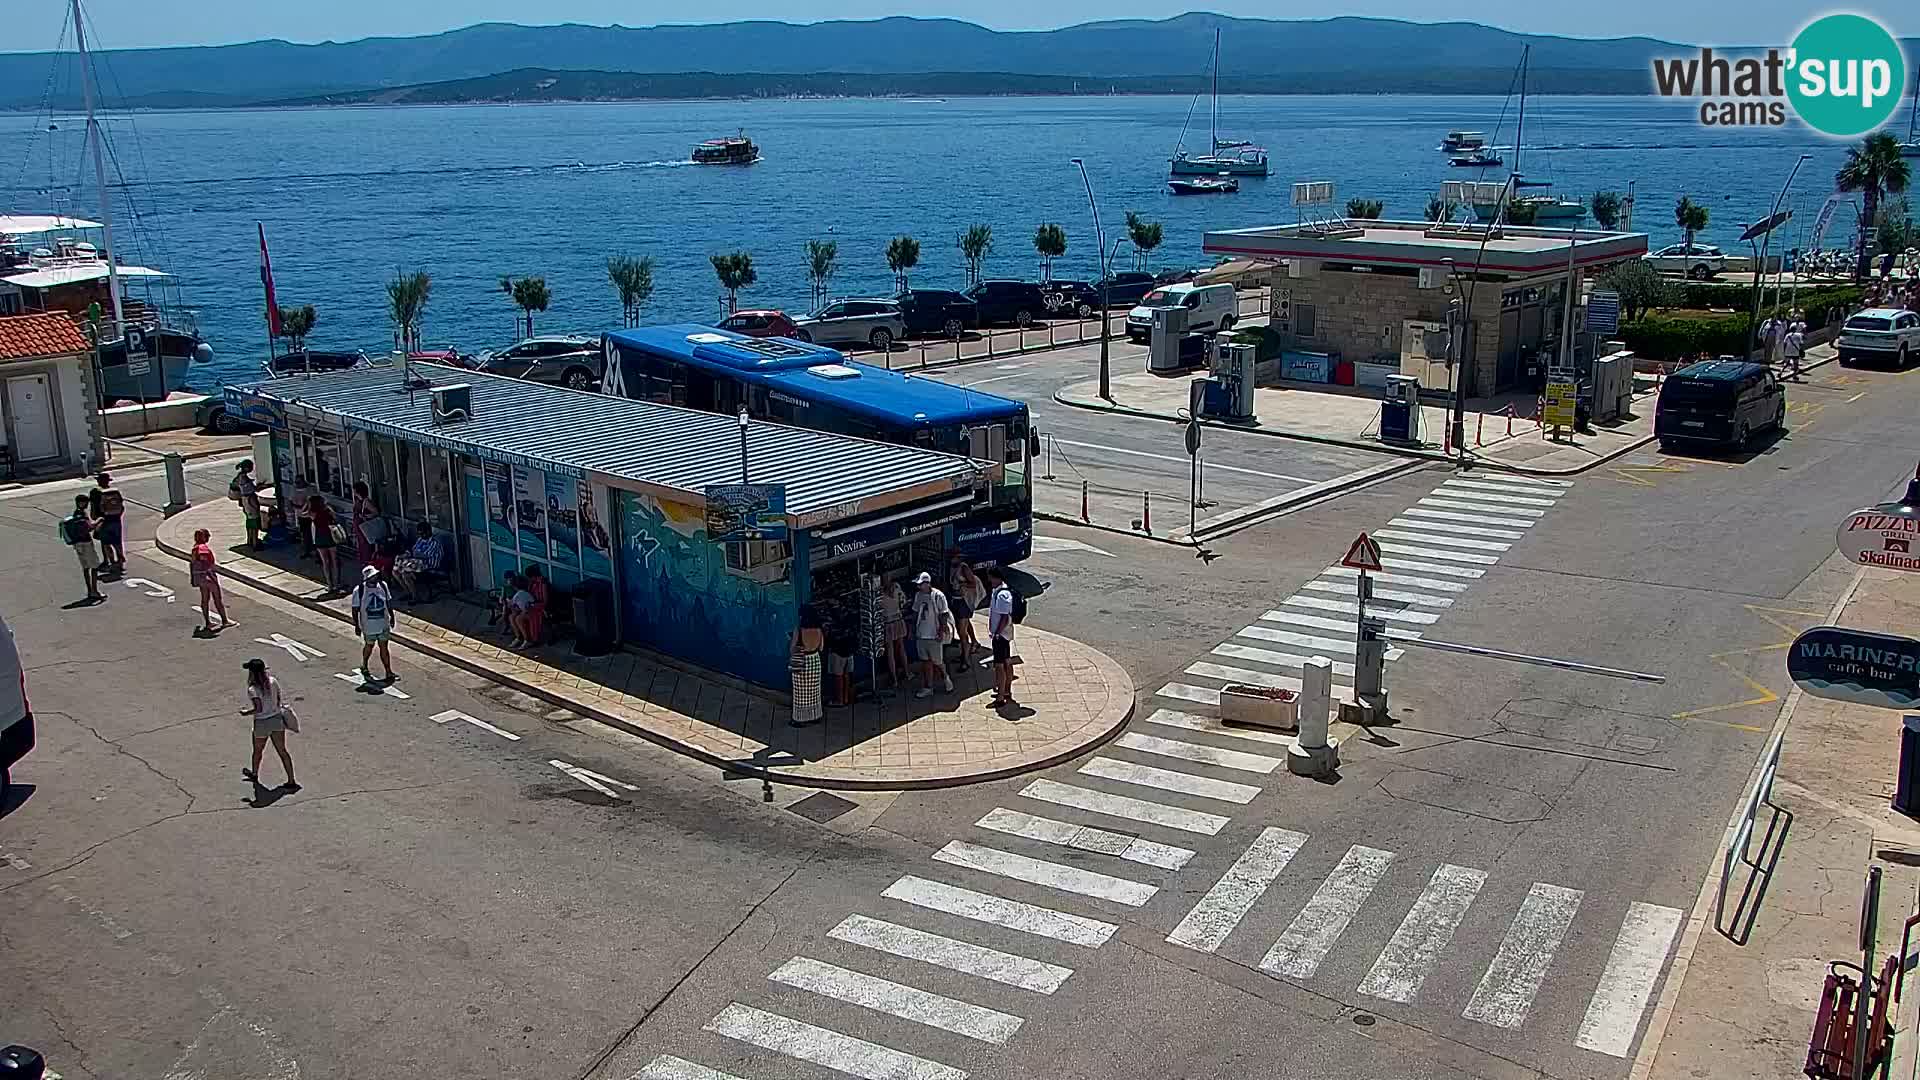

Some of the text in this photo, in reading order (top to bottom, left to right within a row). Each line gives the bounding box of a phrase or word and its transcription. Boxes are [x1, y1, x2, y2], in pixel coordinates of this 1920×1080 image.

[435, 437, 467, 453] POSTAJA
[493, 449, 526, 465] STATION
[527, 457, 553, 472] TICKET
[554, 463, 581, 478] OFFICE
[1881, 530, 1917, 541] GRILL
[1828, 663, 1896, 680] caffe bar
